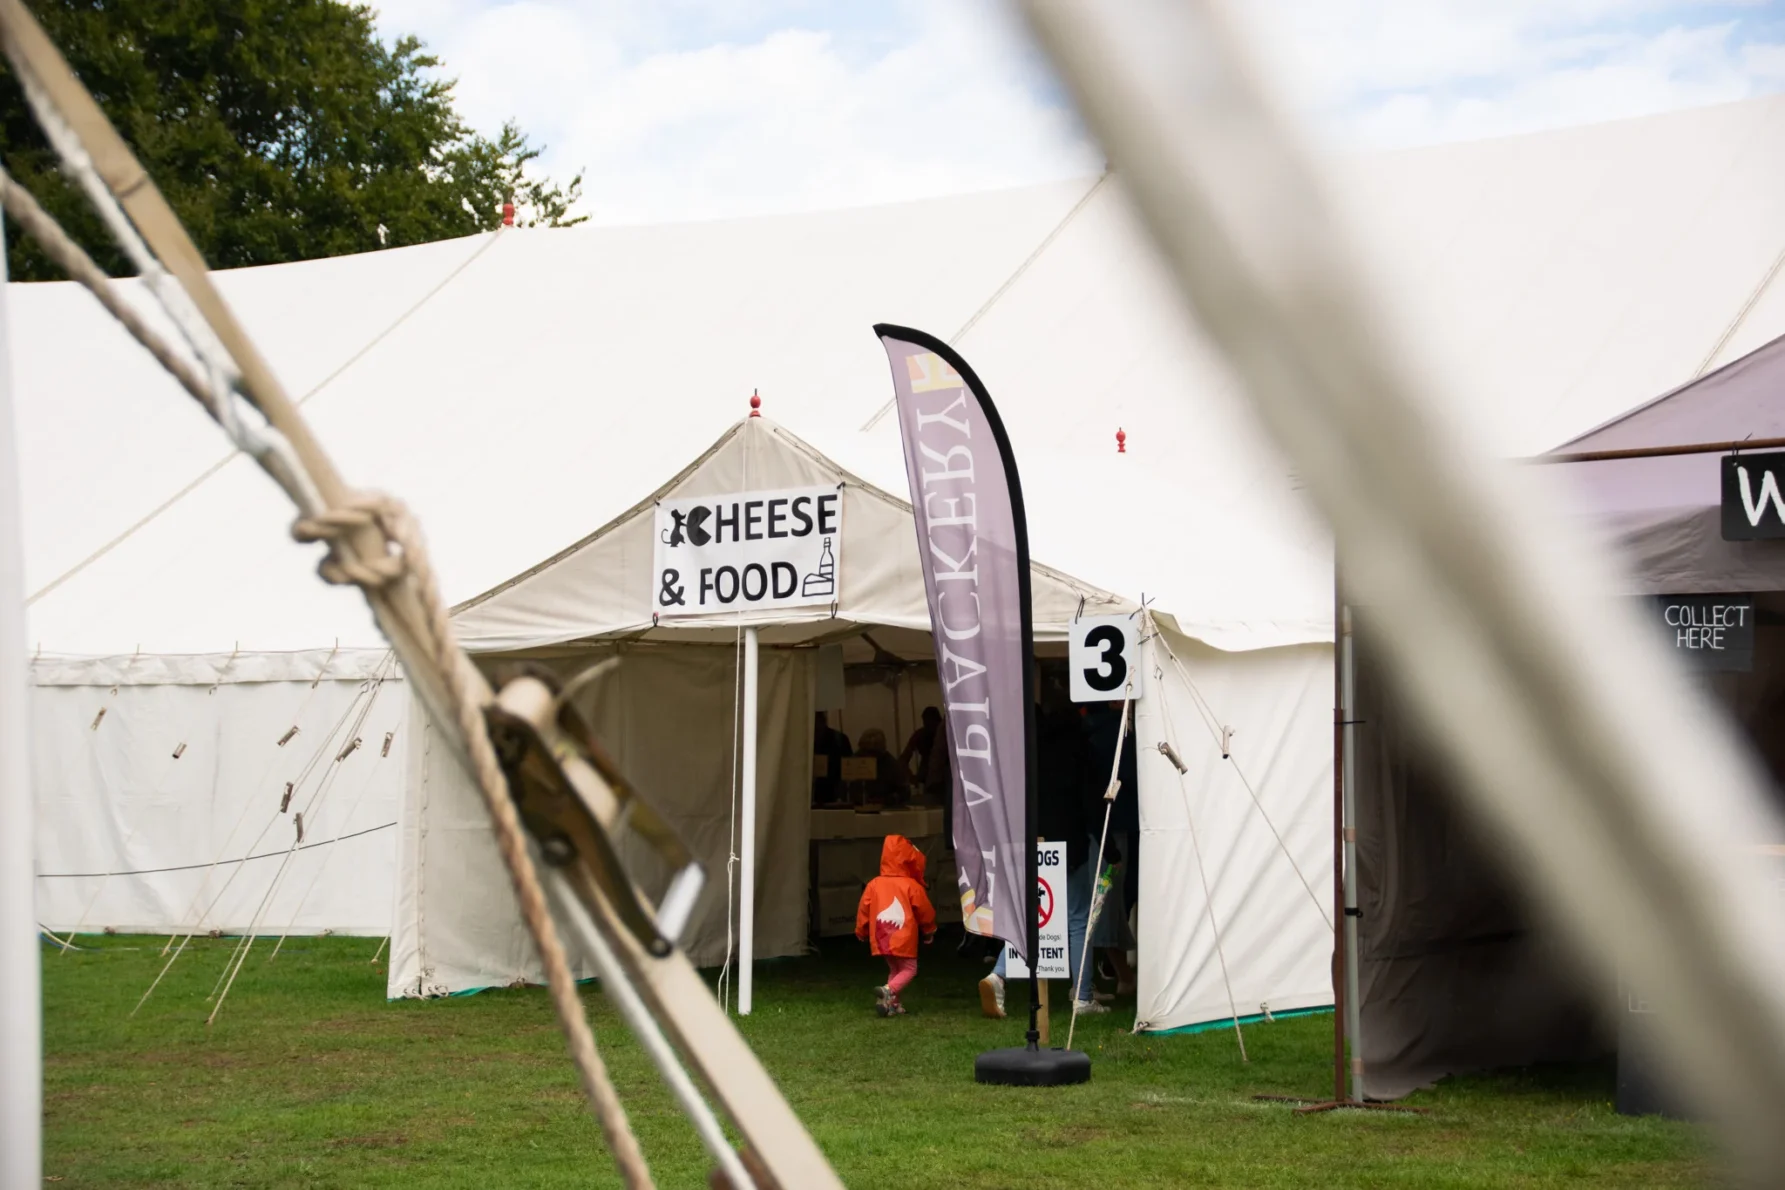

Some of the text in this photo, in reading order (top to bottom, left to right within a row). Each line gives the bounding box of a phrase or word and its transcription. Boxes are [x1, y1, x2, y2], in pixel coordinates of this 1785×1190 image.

[686, 494, 838, 547] CHEESE
[659, 561, 798, 607] & FOOD
[1664, 605, 1750, 628] COLLECT
[1676, 627, 1726, 650] HERE
[1083, 624, 1127, 692] 3
[1037, 850, 1060, 866] OGS
[1040, 947, 1064, 959] TENT
